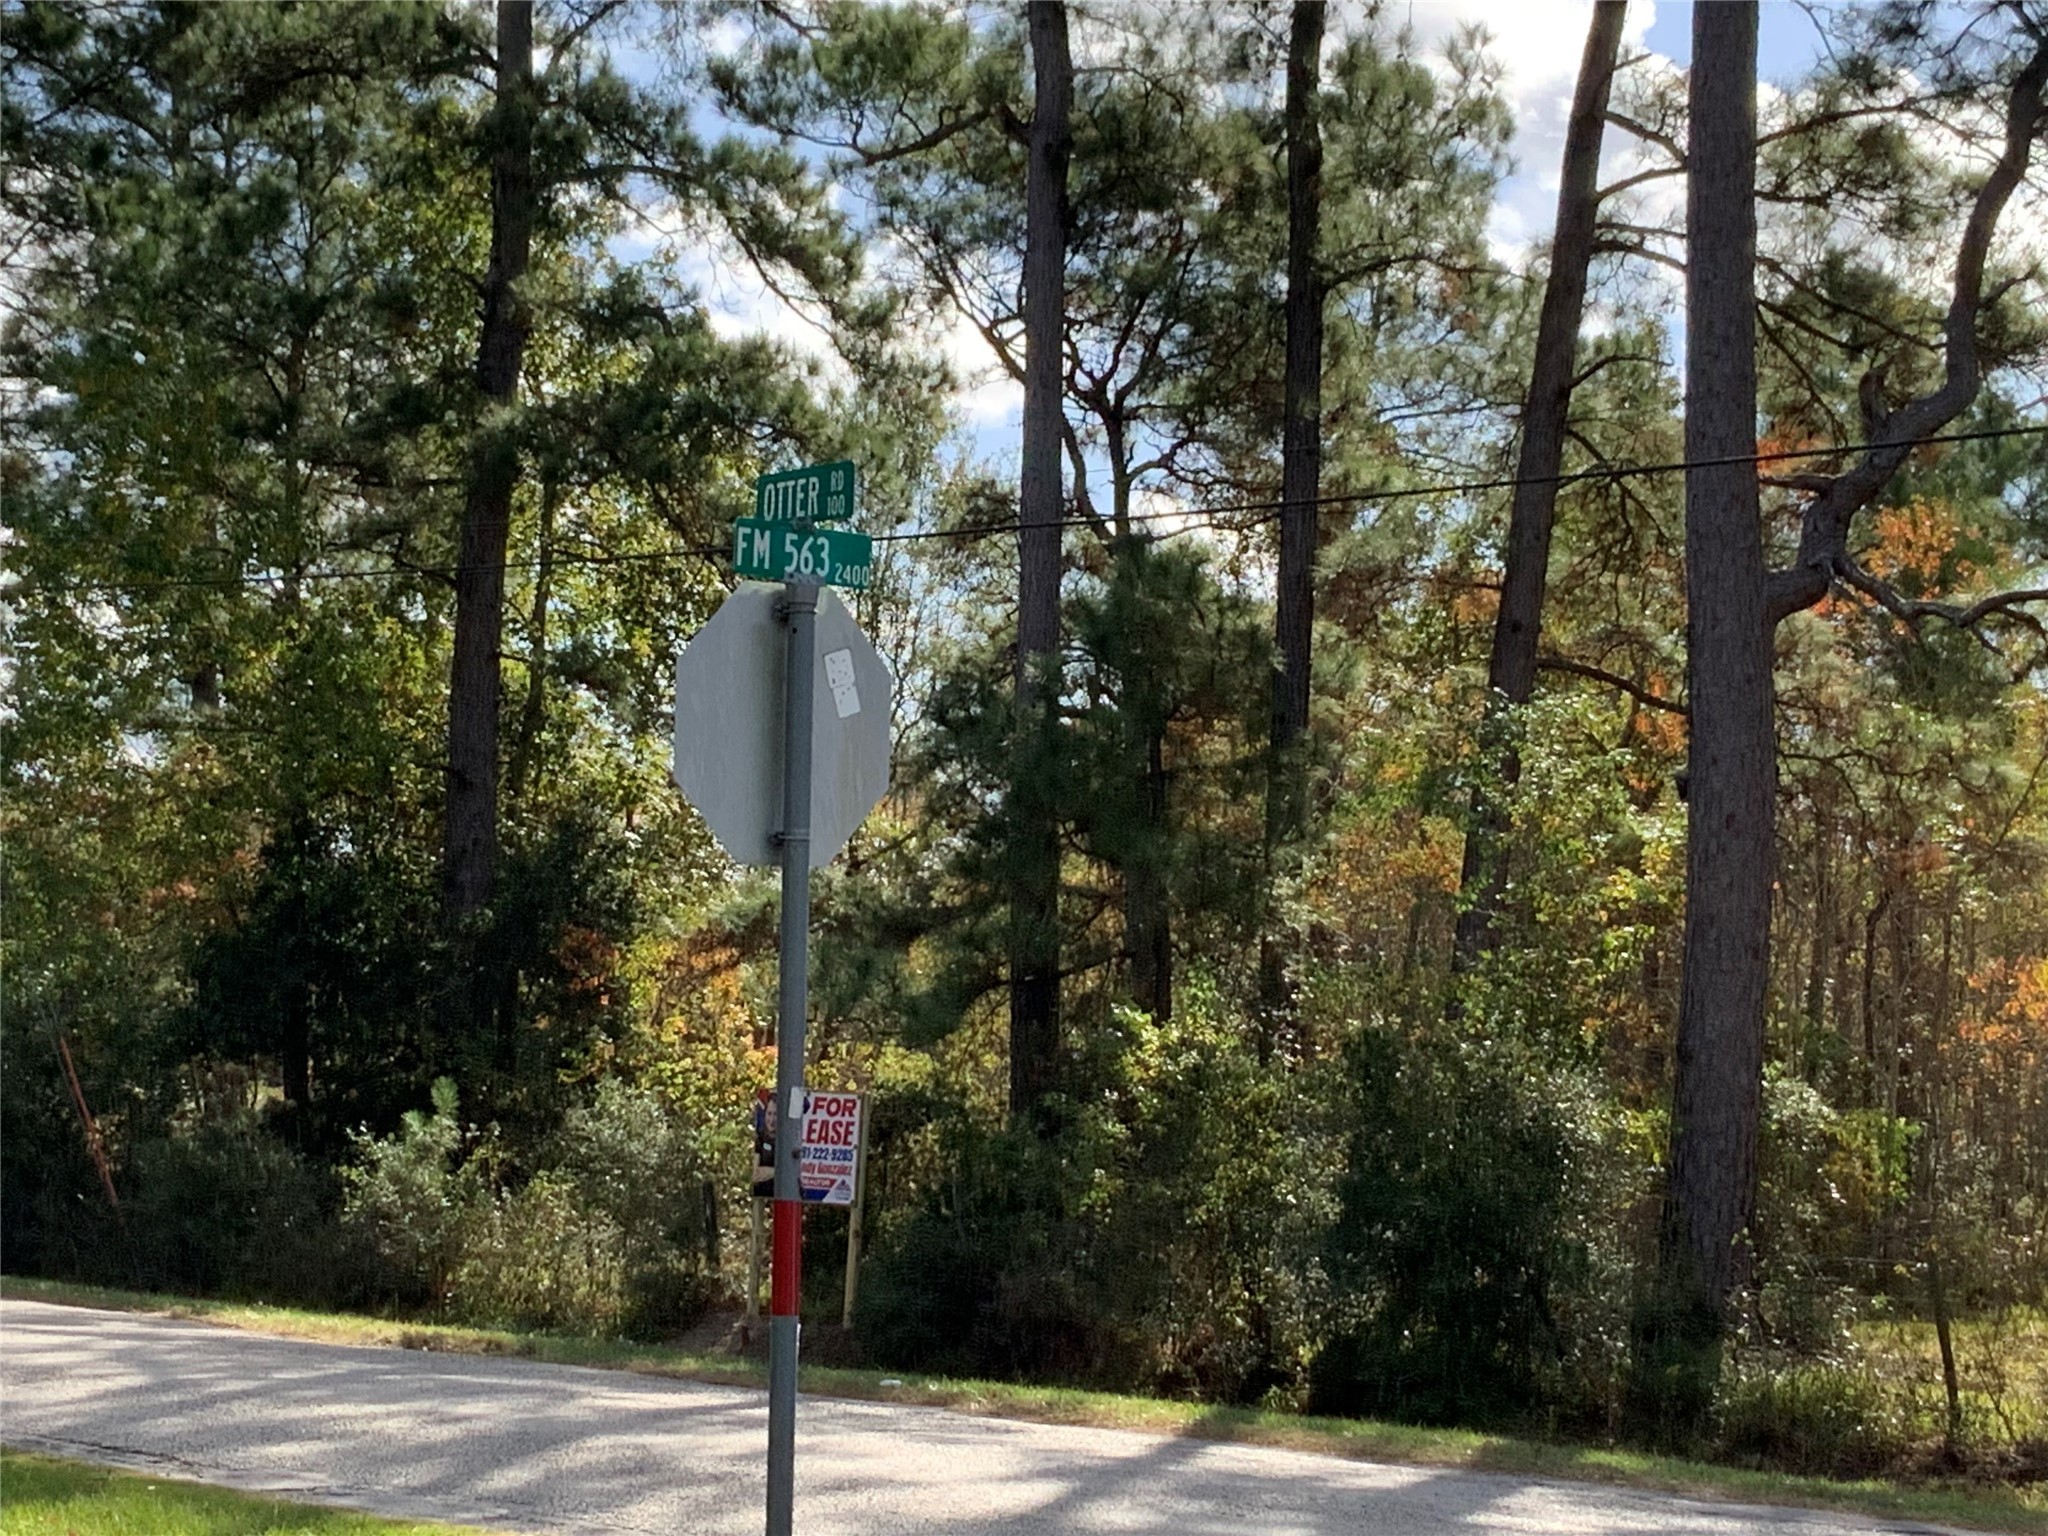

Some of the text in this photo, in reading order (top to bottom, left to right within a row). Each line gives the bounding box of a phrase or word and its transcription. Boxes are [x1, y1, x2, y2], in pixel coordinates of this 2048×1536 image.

[764, 471, 845, 521] OTTER RD
[828, 495, 845, 515] 100
[737, 527, 870, 587] FM 563 2400
[812, 1096, 857, 1117] FOR
[802, 1119, 855, 1146] EASE
